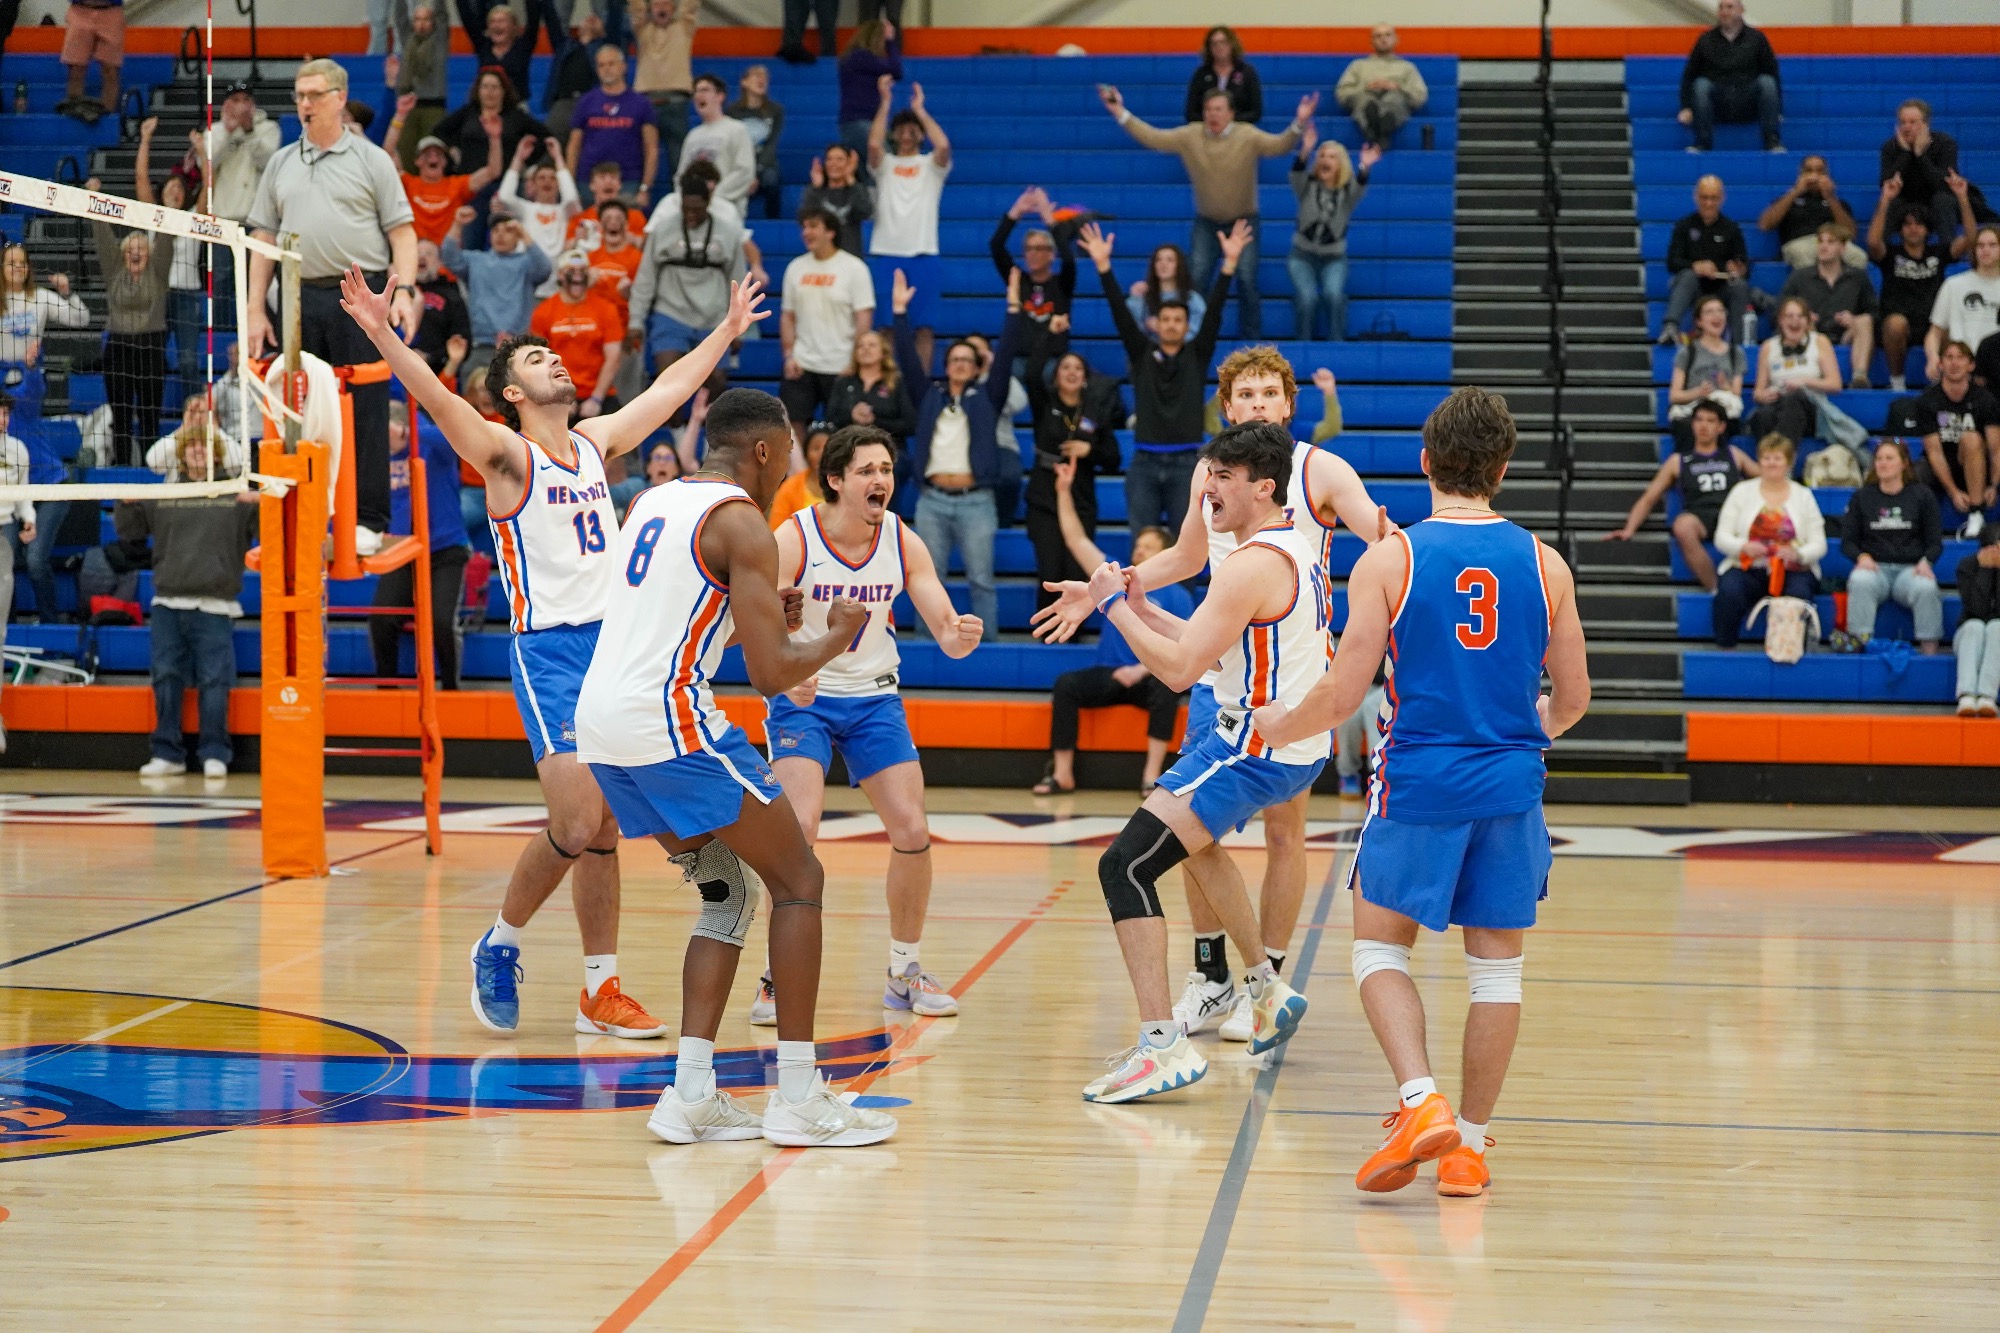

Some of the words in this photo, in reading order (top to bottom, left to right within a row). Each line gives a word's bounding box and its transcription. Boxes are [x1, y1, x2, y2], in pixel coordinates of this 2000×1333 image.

[572, 509, 606, 556] 13
[626, 516, 666, 588] 8
[811, 583, 845, 602] NEW
[849, 583, 894, 603] PALTZ
[1455, 567, 1499, 650] 3
